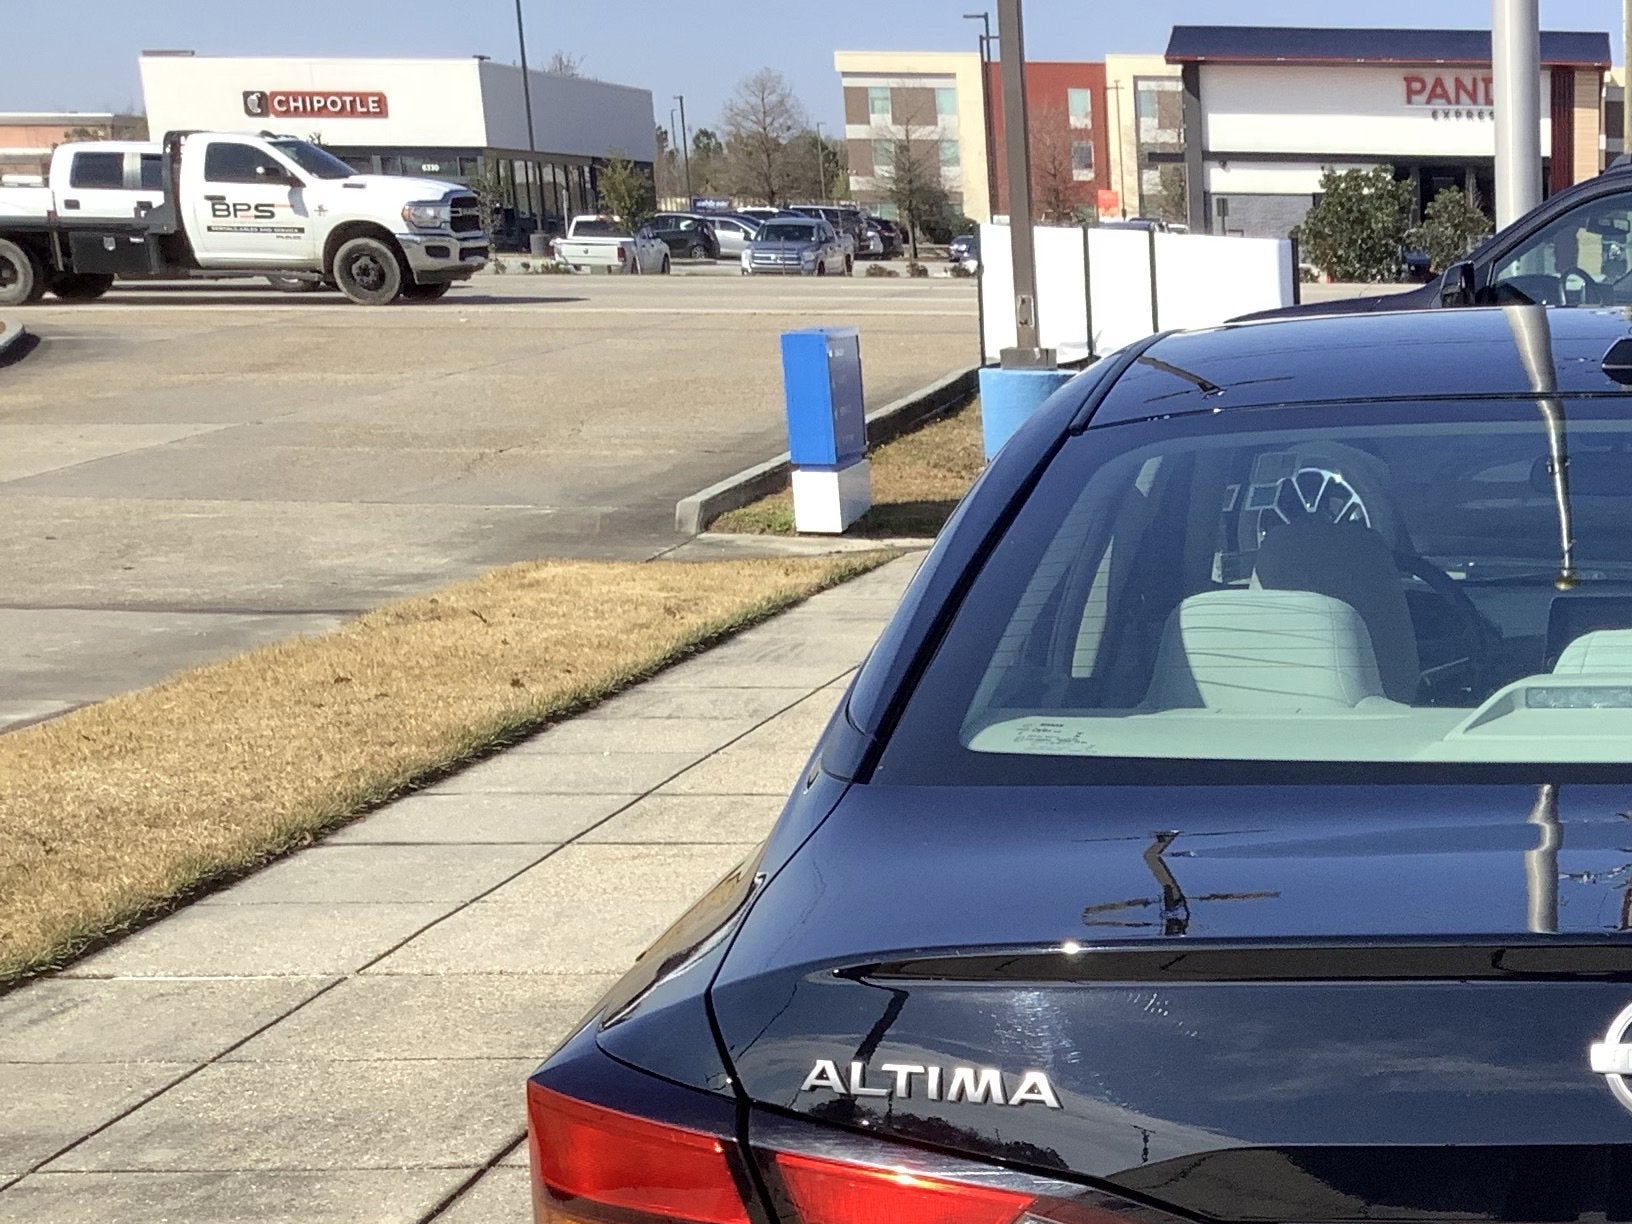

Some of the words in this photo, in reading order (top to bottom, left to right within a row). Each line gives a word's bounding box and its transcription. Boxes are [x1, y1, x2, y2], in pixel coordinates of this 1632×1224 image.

[1403, 76, 1494, 106] PAND
[273, 96, 381, 112] CHIPOTLE
[1431, 109, 1494, 120] EXPRES
[211, 202, 276, 220] BPS
[800, 1059, 1063, 1109] ALTIMA
